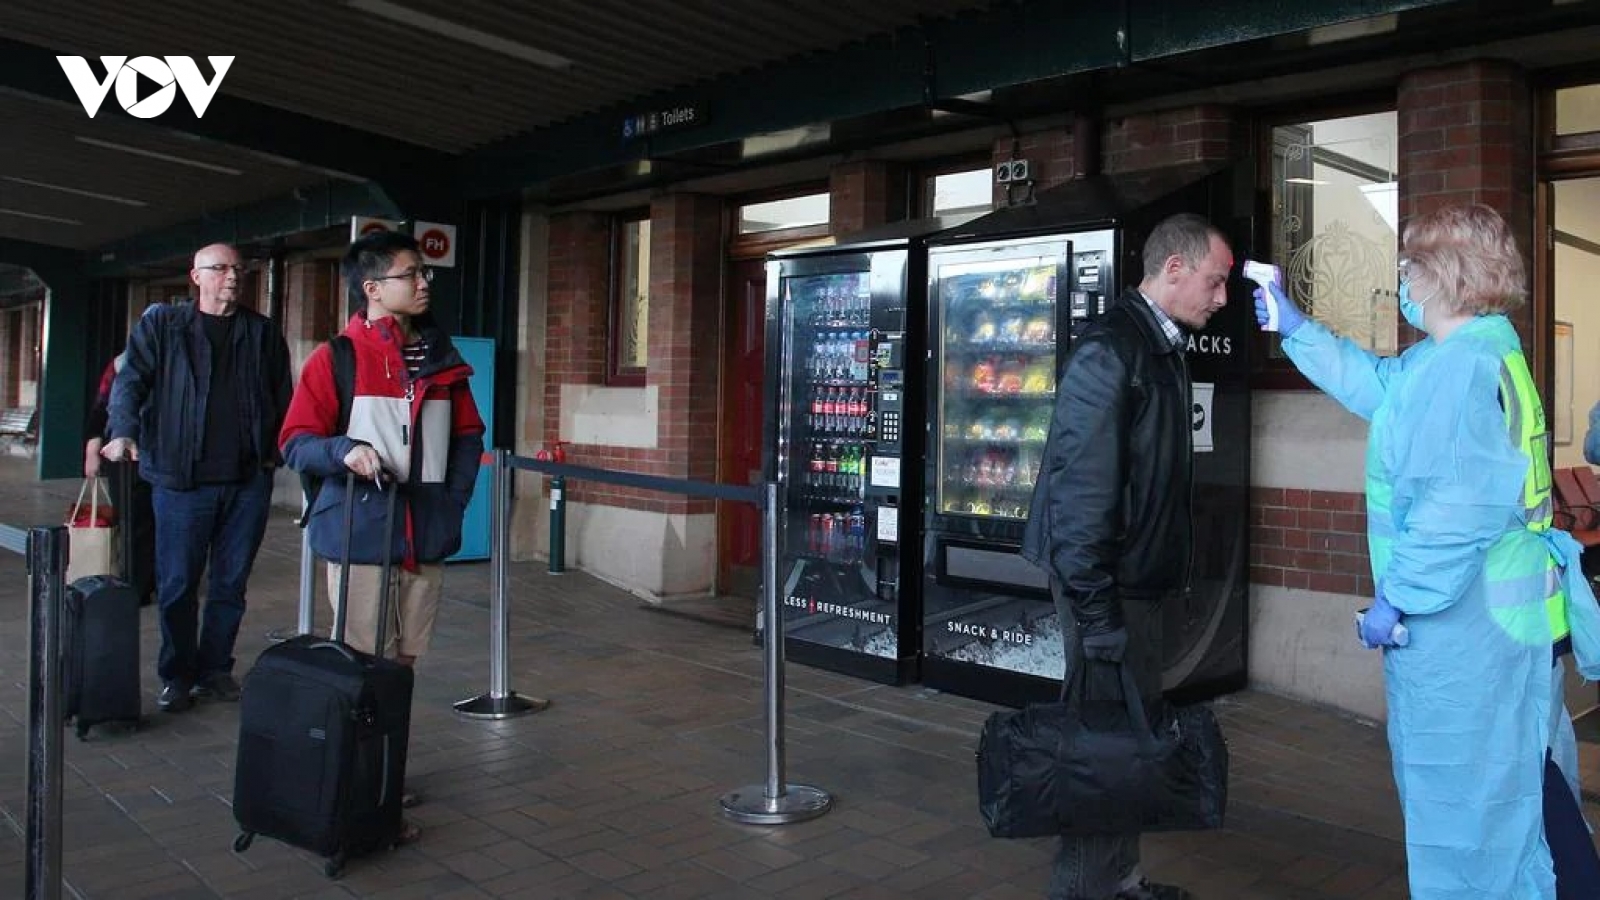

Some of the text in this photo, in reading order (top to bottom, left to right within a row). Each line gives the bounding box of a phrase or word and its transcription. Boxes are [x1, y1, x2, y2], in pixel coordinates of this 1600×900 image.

[661, 107, 695, 126] Toilets
[425, 238, 445, 251] FH
[1185, 333, 1232, 355] ACKS
[783, 595, 892, 625] LESS REFRESHMENT
[947, 621, 1032, 646] SNACK & RIDE
